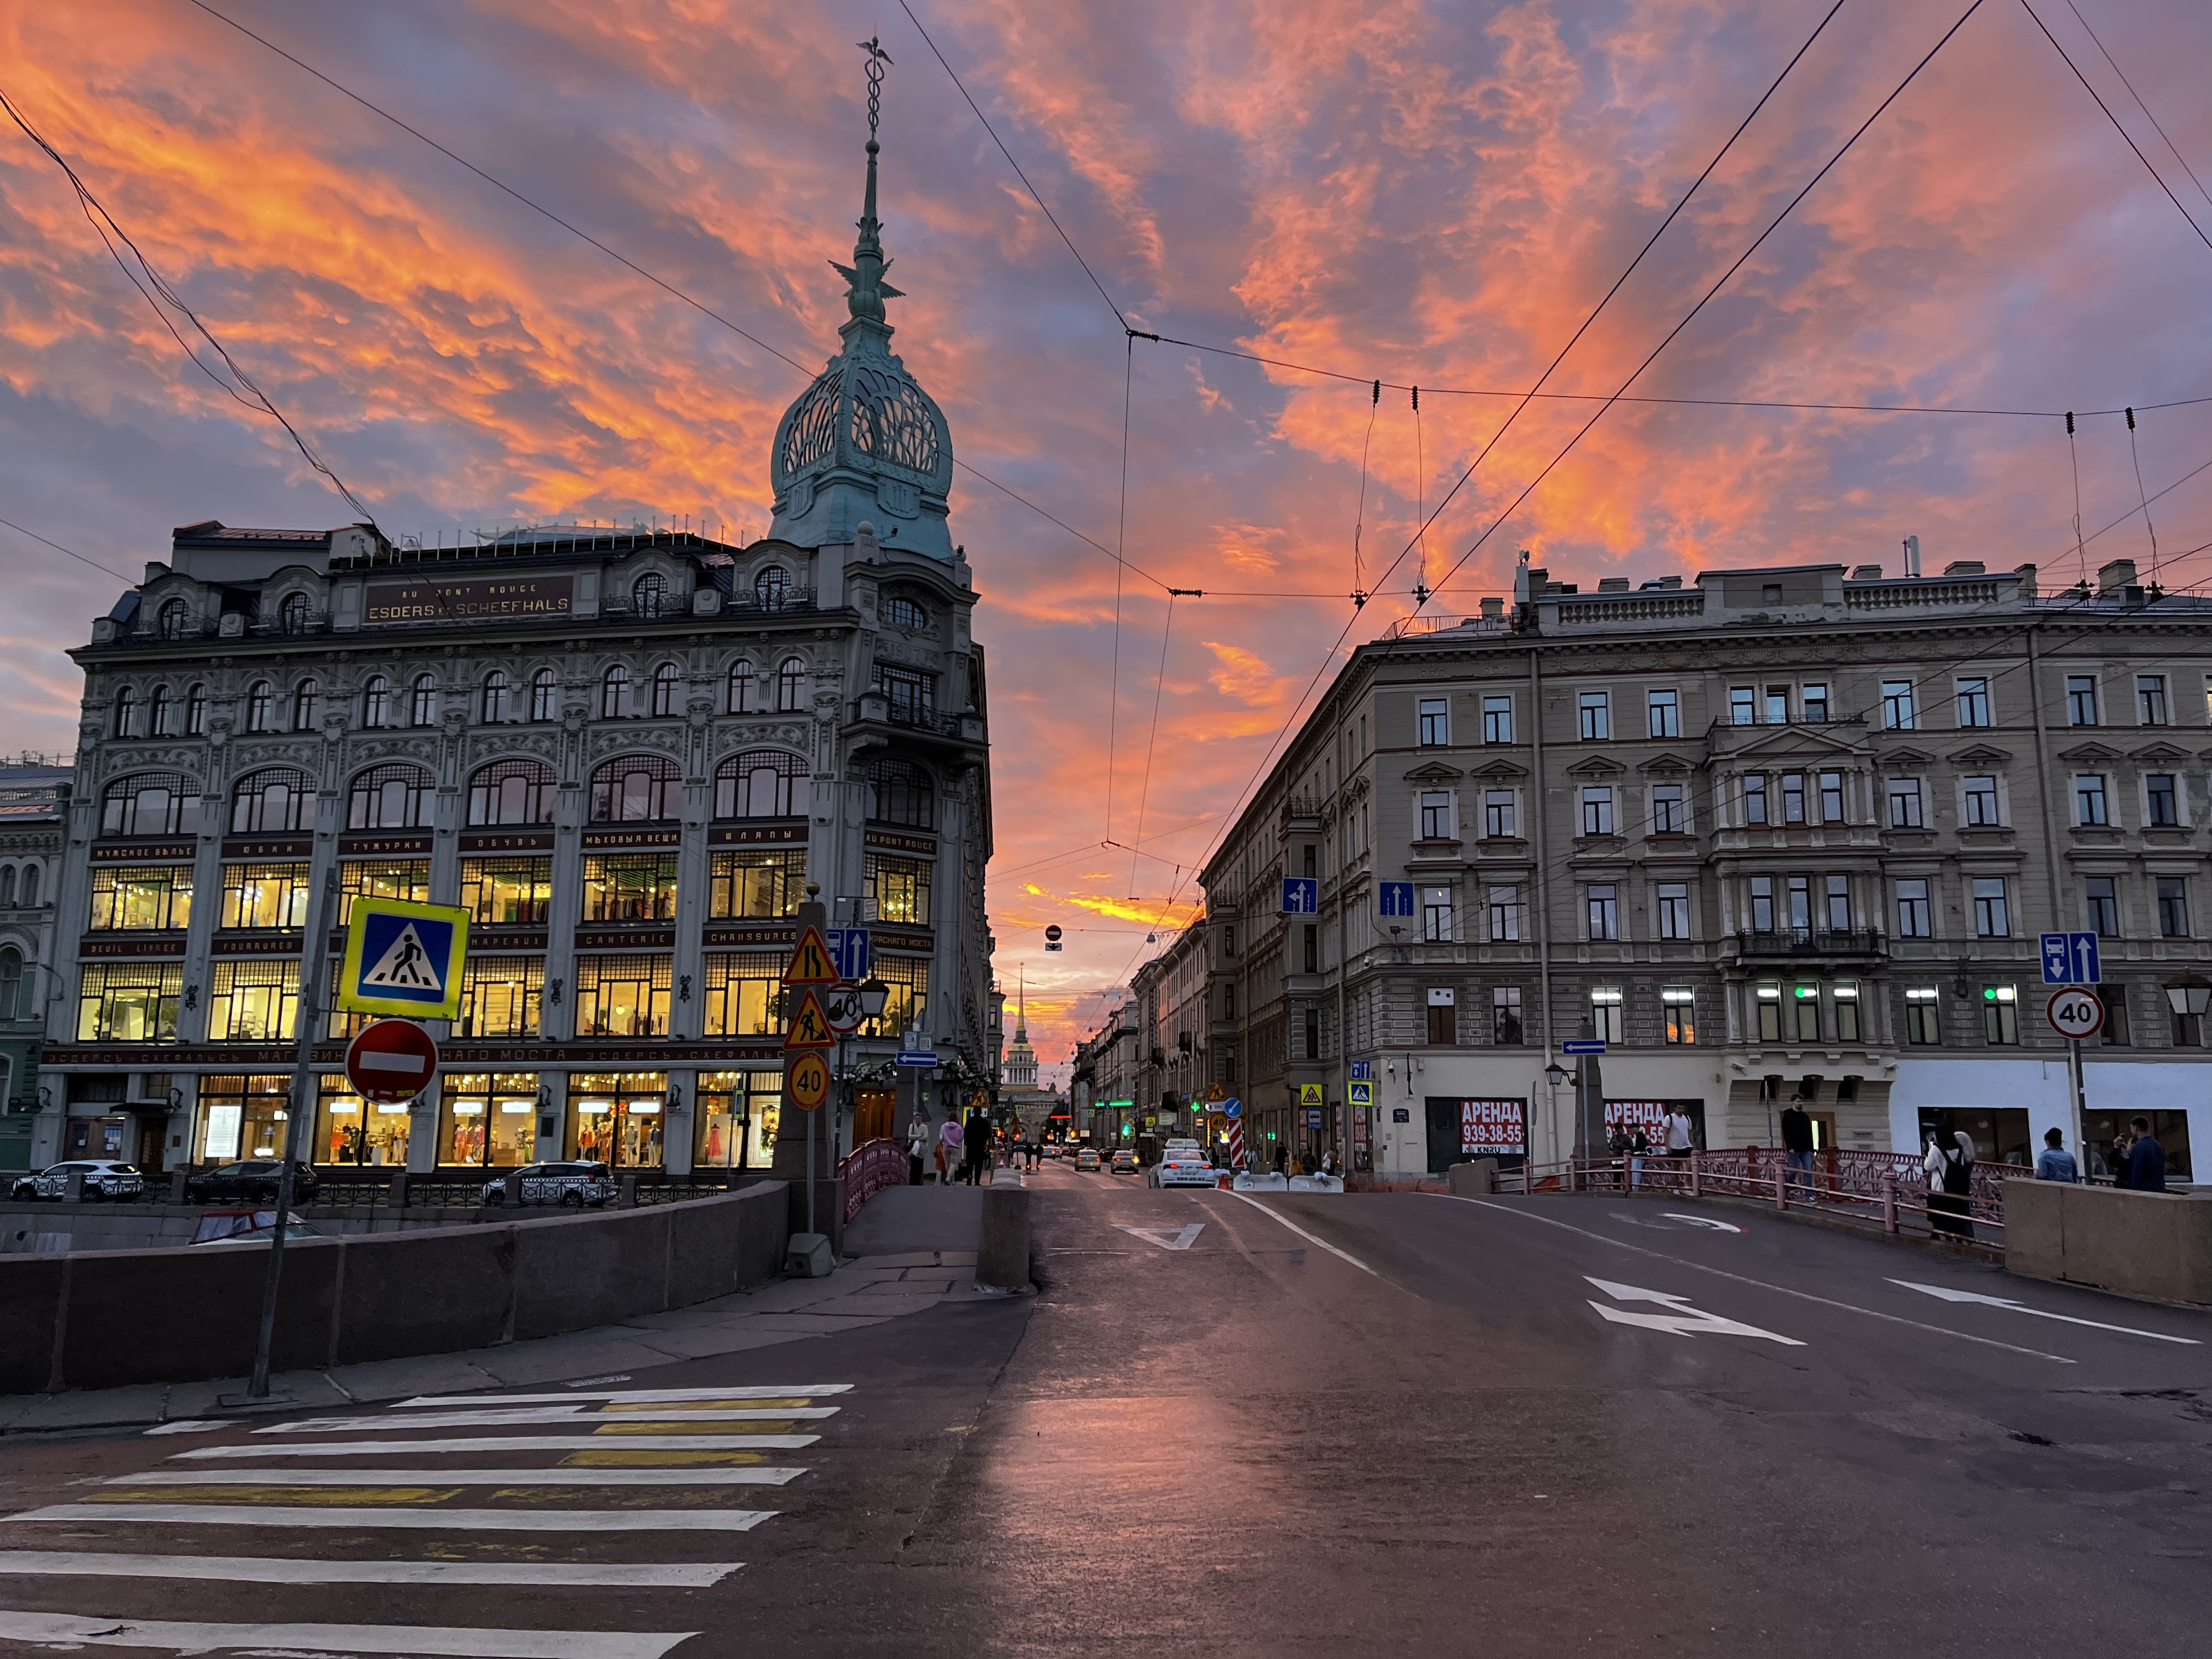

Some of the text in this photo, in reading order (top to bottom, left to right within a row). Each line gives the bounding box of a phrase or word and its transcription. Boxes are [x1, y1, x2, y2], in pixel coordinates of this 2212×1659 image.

[489, 584, 536, 594] ROUGE
[369, 605, 434, 619] ESDERS
[456, 598, 568, 615] SCHEEFHALS
[647, 834, 677, 843] ВЕЩИ
[725, 831, 792, 840] ШЛЯПЫ
[353, 842, 421, 851] ТУЖУРКИ
[478, 838, 537, 848] ОБУВЬ
[866, 834, 934, 851] AU PONT ROUGE
[97, 849, 149, 857] МУЖСКОЕ
[243, 845, 293, 854] ЮБКИ
[471, 937, 539, 946] HAPEAUX
[711, 932, 797, 942] CHAUSSURES
[870, 935, 932, 948] КРАСНАГО МОСТА
[91, 944, 122, 953] DEUIL
[223, 941, 293, 951] FOURRURES
[2059, 1003, 2091, 1023] 40
[258, 1050, 345, 1062] МАГЗИН
[500, 1049, 566, 1060] МОСТА
[586, 1051, 670, 1061] ЭСДЕРСЪ
[690, 1051, 785, 1060] СХЕФАЛЬС
[797, 1069, 821, 1092] 40
[1462, 1102, 1522, 1124] АРЕНДА
[1604, 1103, 1665, 1124] АРЕНДА
[1213, 1119, 1224, 1127] 40
[1464, 1125, 1522, 1142] 939-38-55
